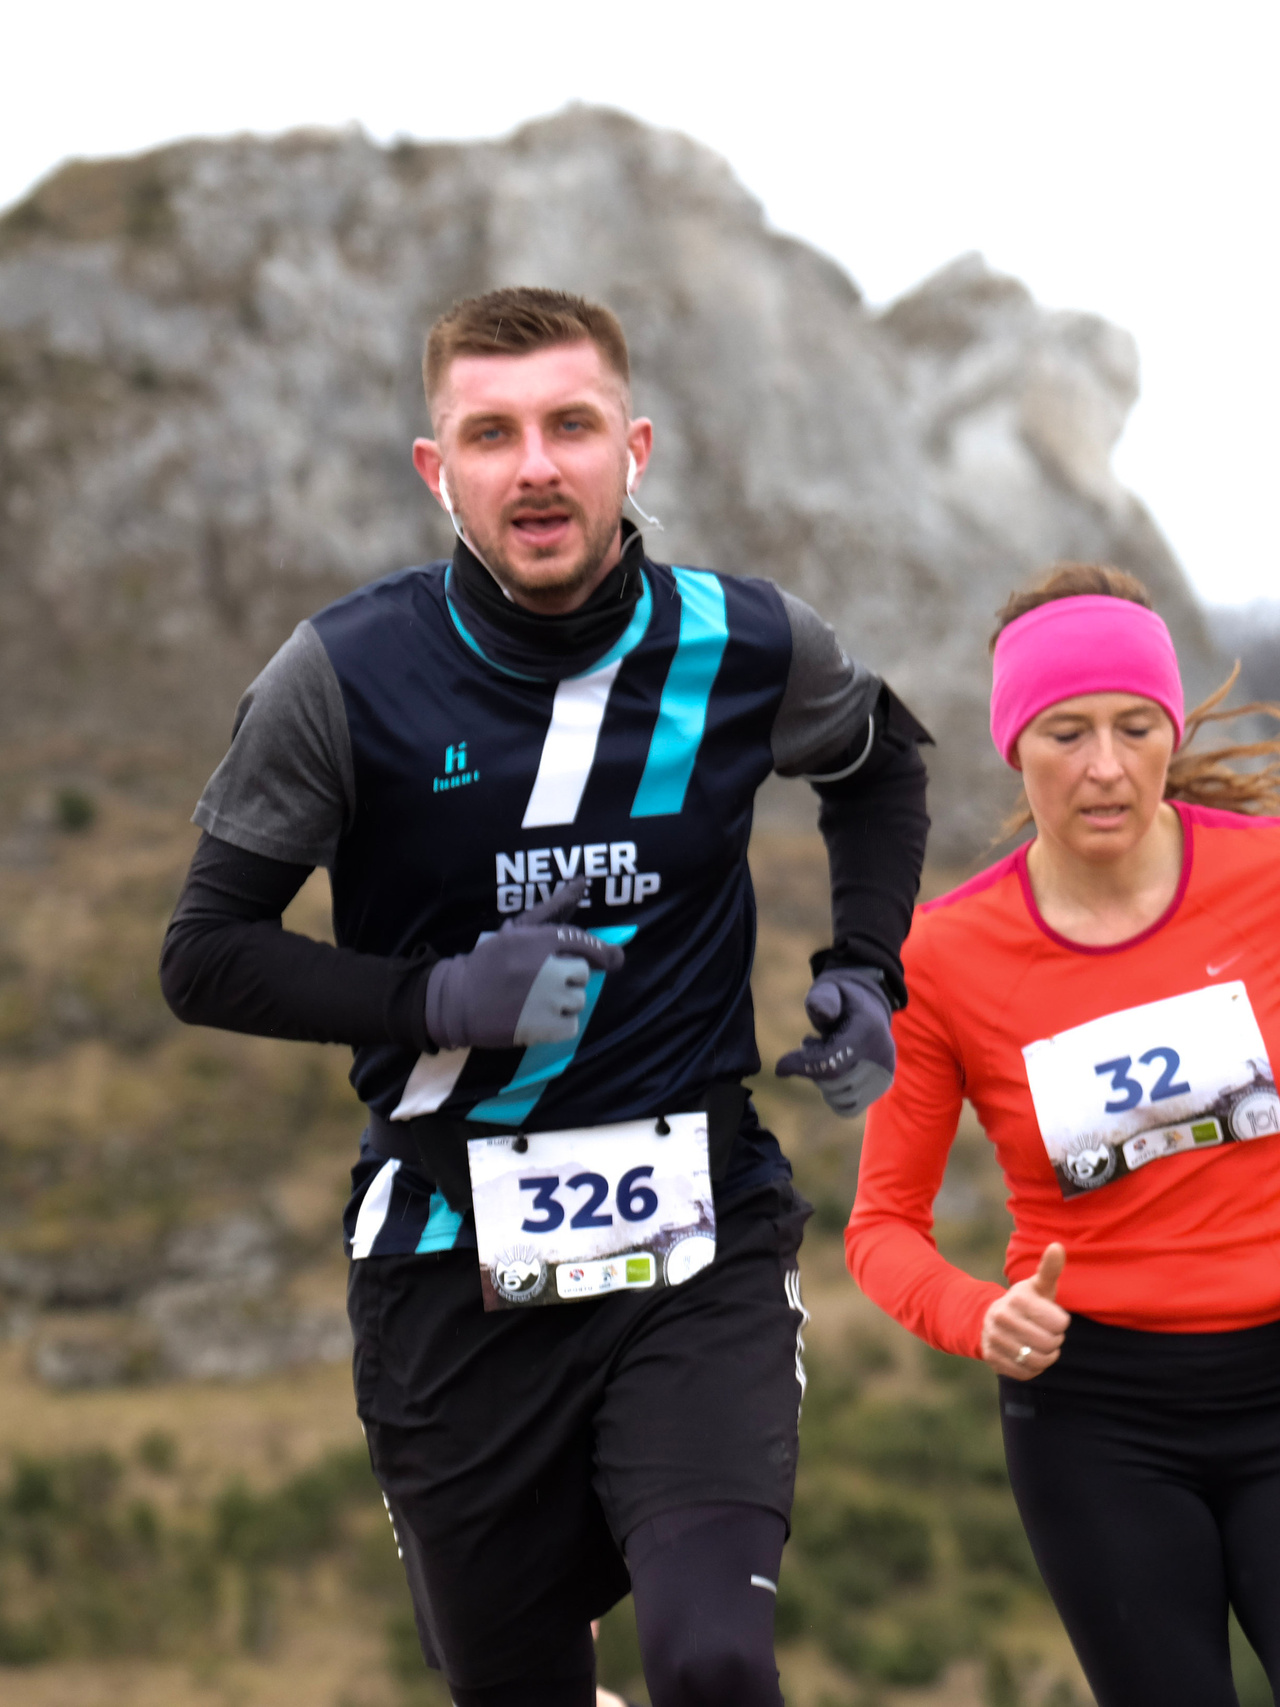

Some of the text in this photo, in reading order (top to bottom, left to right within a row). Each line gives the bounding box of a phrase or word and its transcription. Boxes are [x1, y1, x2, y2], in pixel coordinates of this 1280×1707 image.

[495, 841, 637, 885] NEVER
[605, 872, 661, 906] UP
[1094, 1046, 1191, 1114] 32
[518, 1165, 658, 1234] 326
